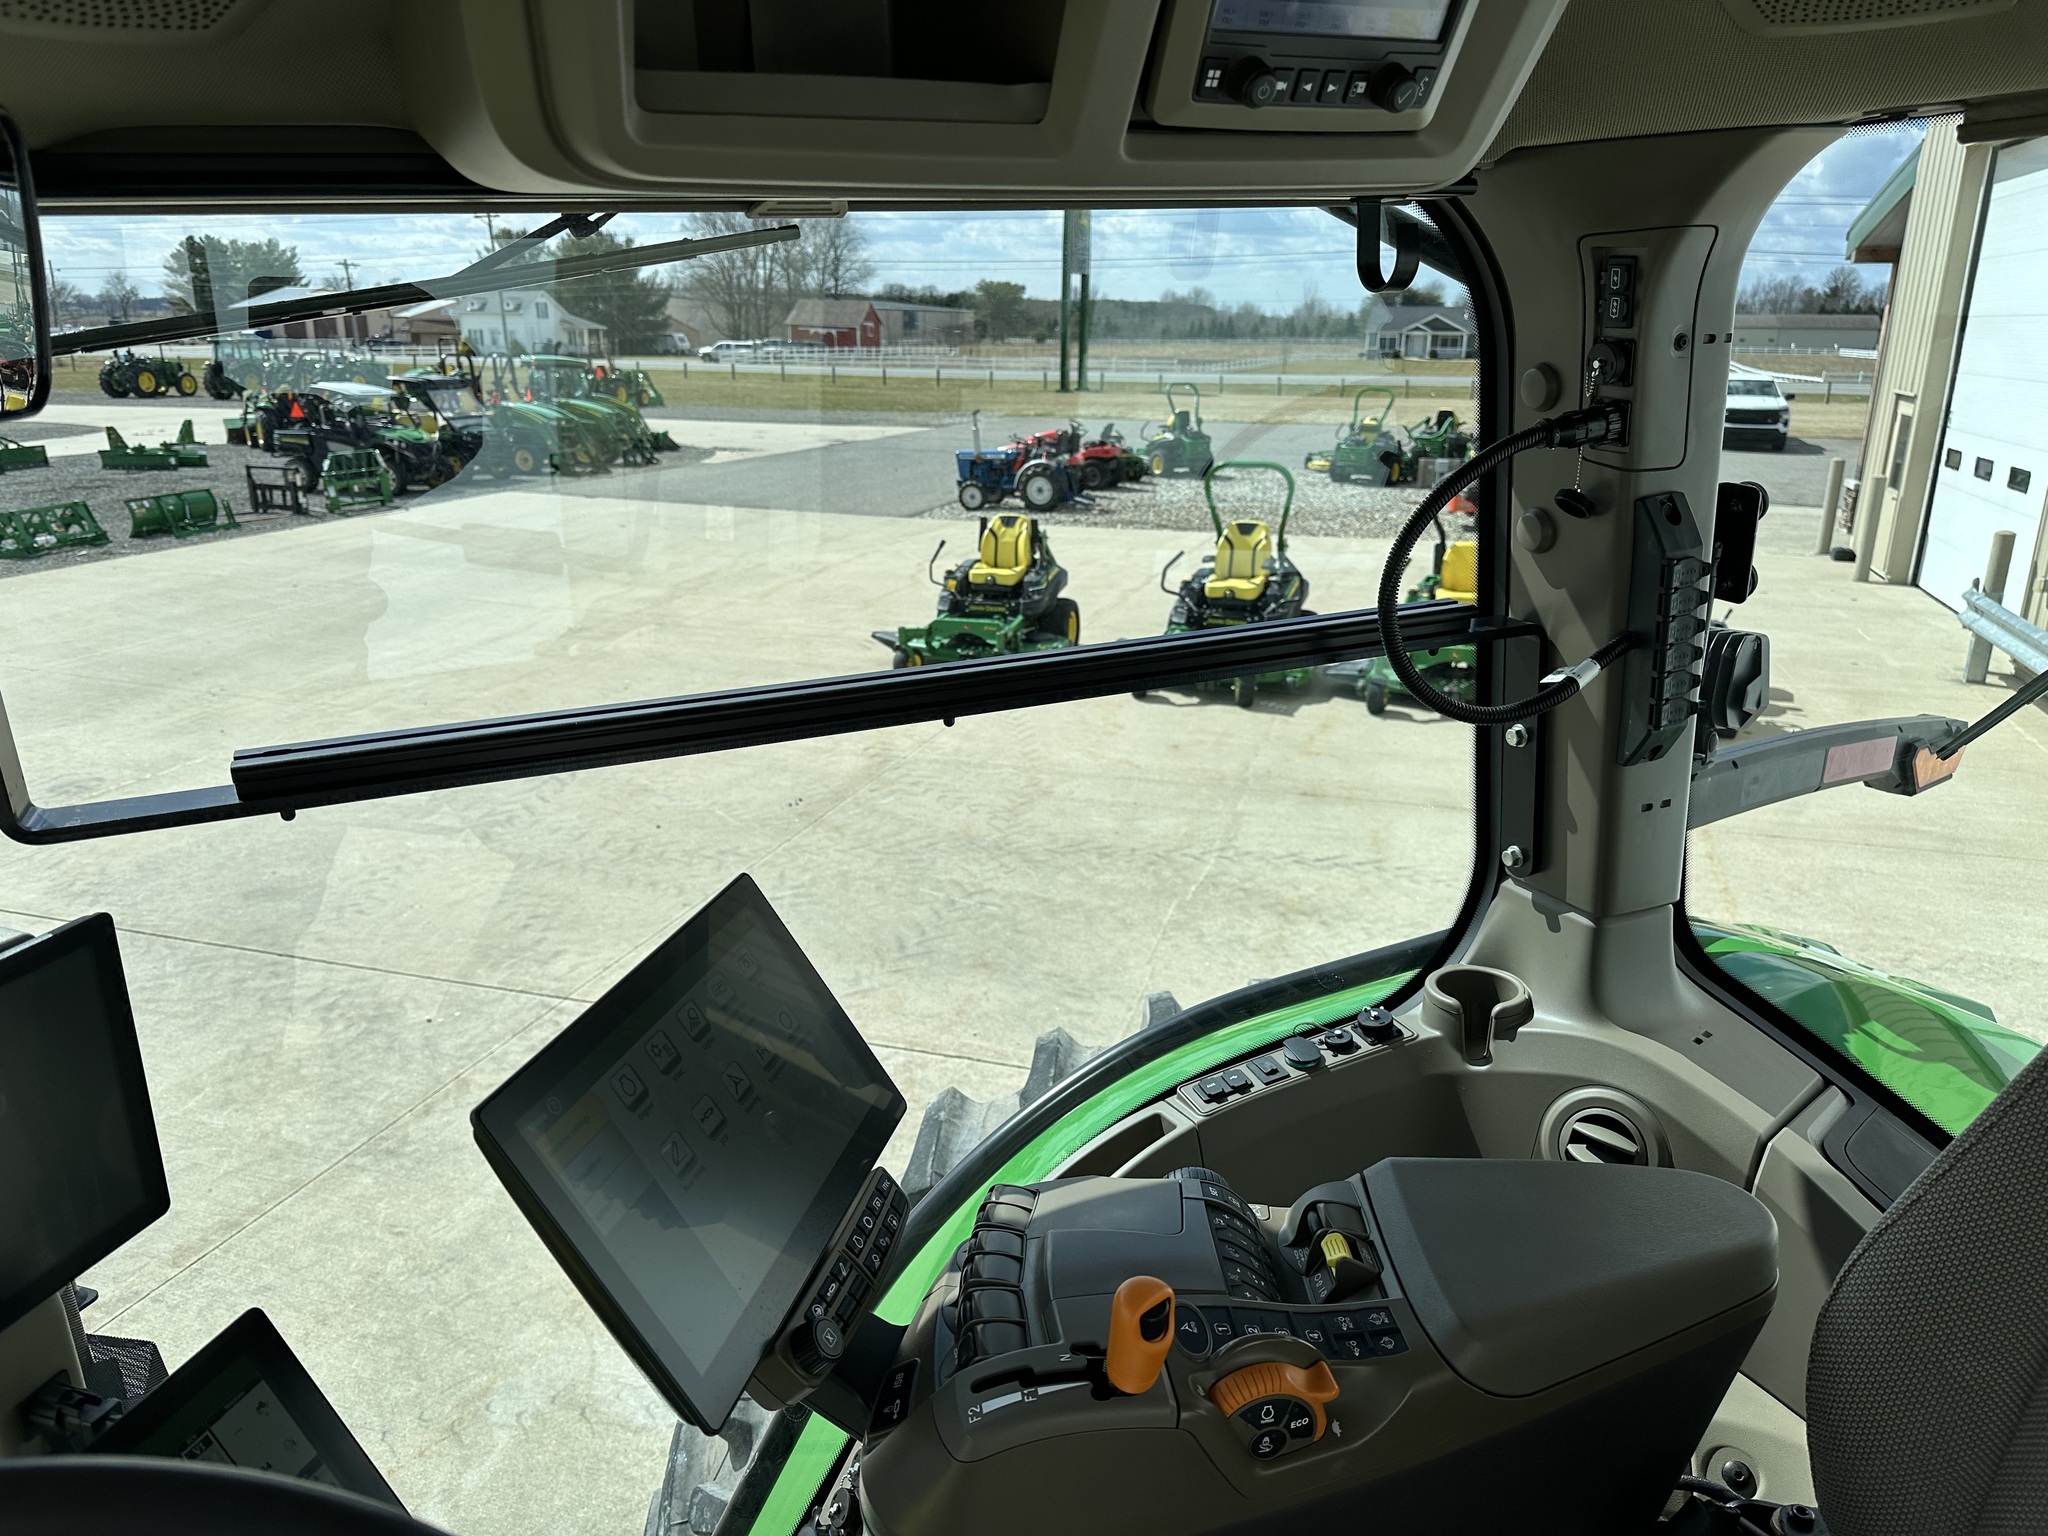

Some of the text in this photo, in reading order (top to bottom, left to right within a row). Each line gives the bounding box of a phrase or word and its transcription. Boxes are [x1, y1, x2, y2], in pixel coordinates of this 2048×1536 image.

[1059, 1354, 1072, 1362] N
[1023, 1387, 1038, 1403] F1
[967, 1404, 982, 1424] F2
[1290, 1417, 1310, 1429] ECO
